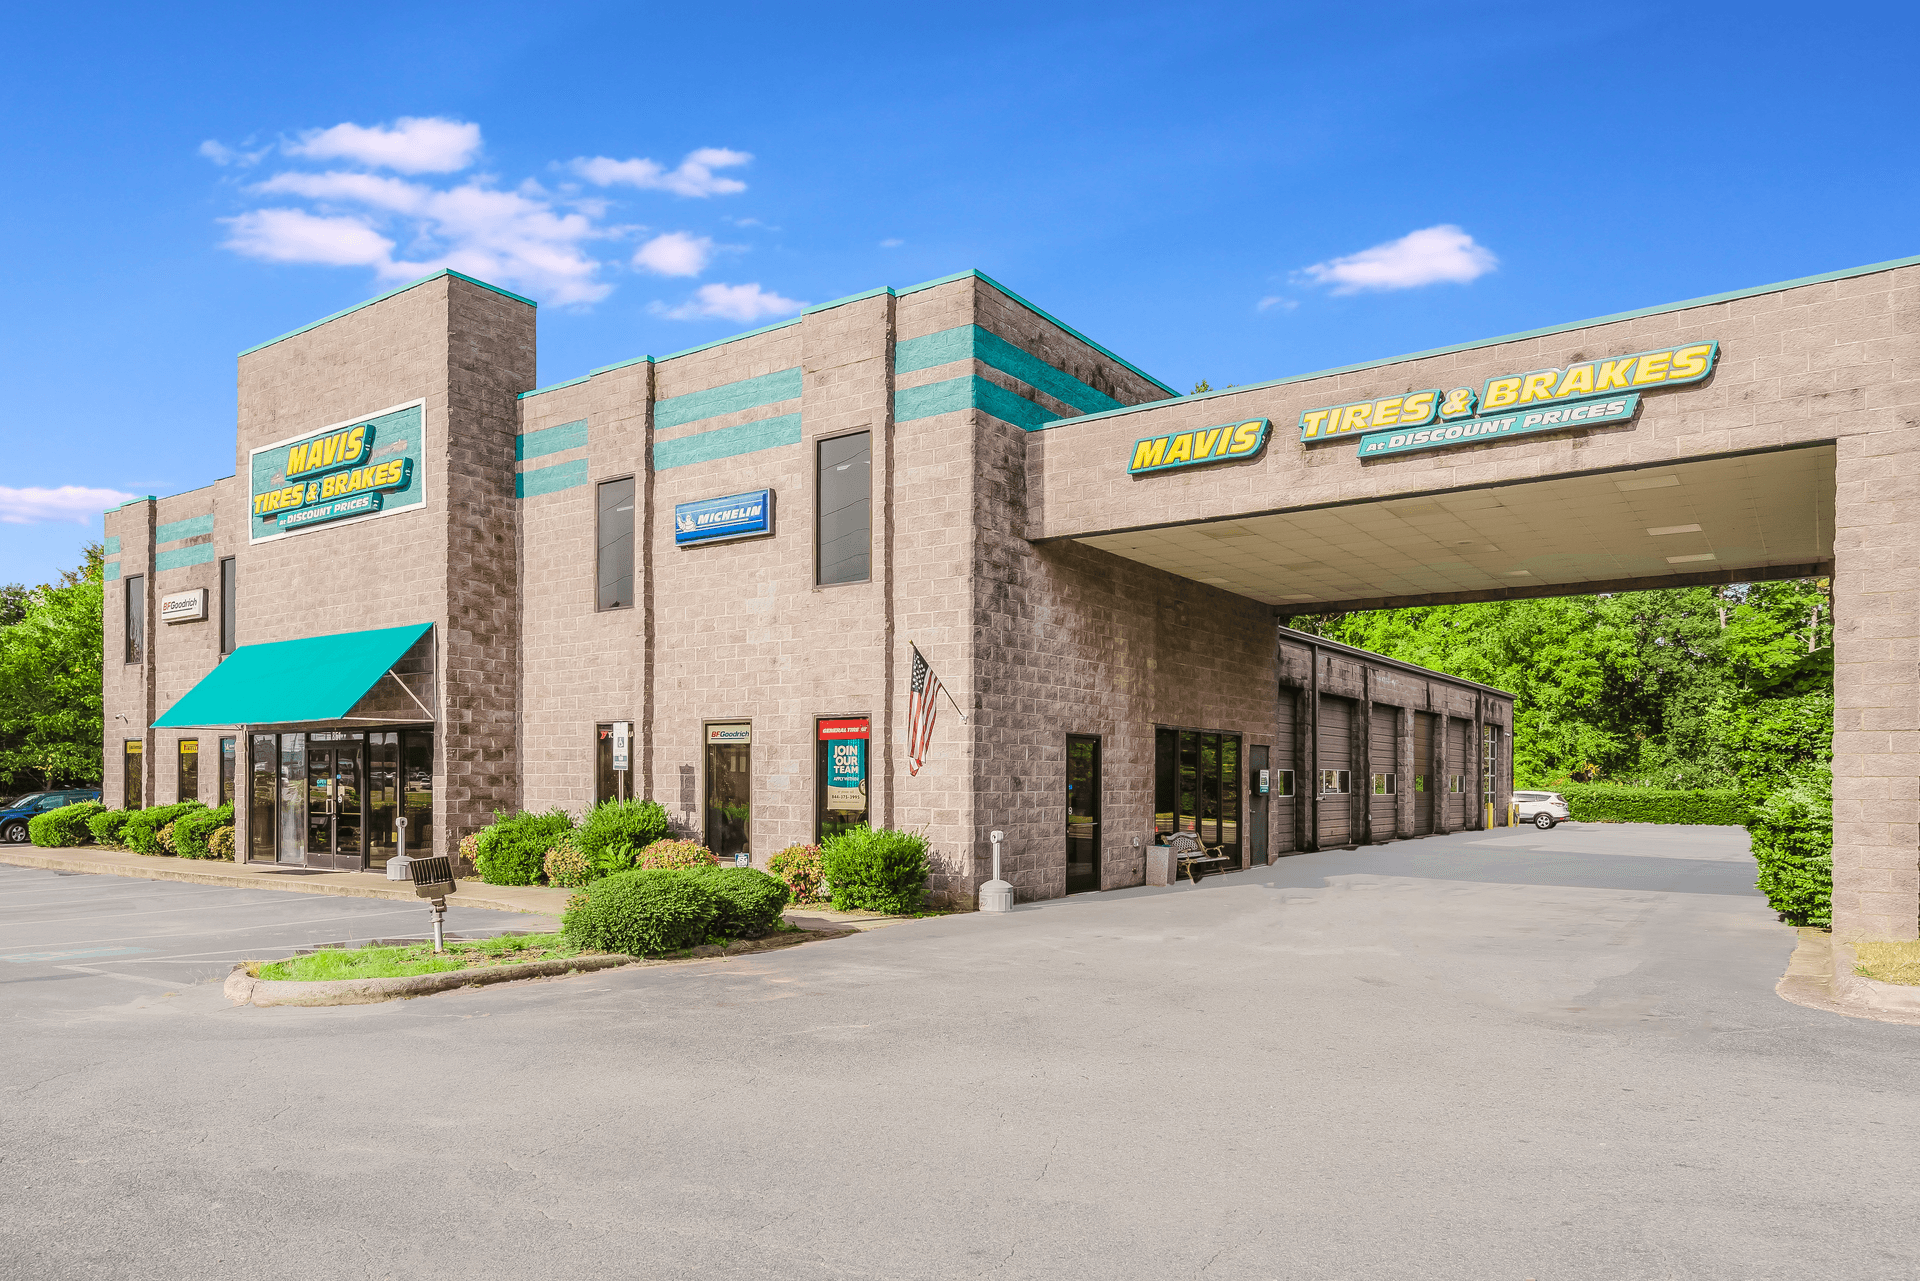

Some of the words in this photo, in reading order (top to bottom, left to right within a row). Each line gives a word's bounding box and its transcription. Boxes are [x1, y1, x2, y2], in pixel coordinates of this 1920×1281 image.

[1131, 421, 1263, 470] MAVIS
[1303, 392, 1436, 438] TIRES
[1441, 388, 1471, 415] &
[1482, 344, 1712, 409] BRAKES
[1387, 418, 1517, 448] DISCOUNT
[1522, 400, 1627, 428] PRICES
[286, 426, 366, 476] MAVIS
[253, 483, 305, 514] TIRES
[306, 481, 319, 502] &
[321, 459, 404, 499] BRAKES
[287, 505, 333, 524] DISCOUNT
[333, 496, 370, 513] PRICES
[697, 504, 762, 525] MICHELIN
[162, 598, 198, 611] BFGoodrich
[711, 730, 749, 738] BFGoodrich
[833, 745, 858, 759] JOIN
[835, 756, 858, 766] OUR
[833, 766, 859, 774] TEAM
